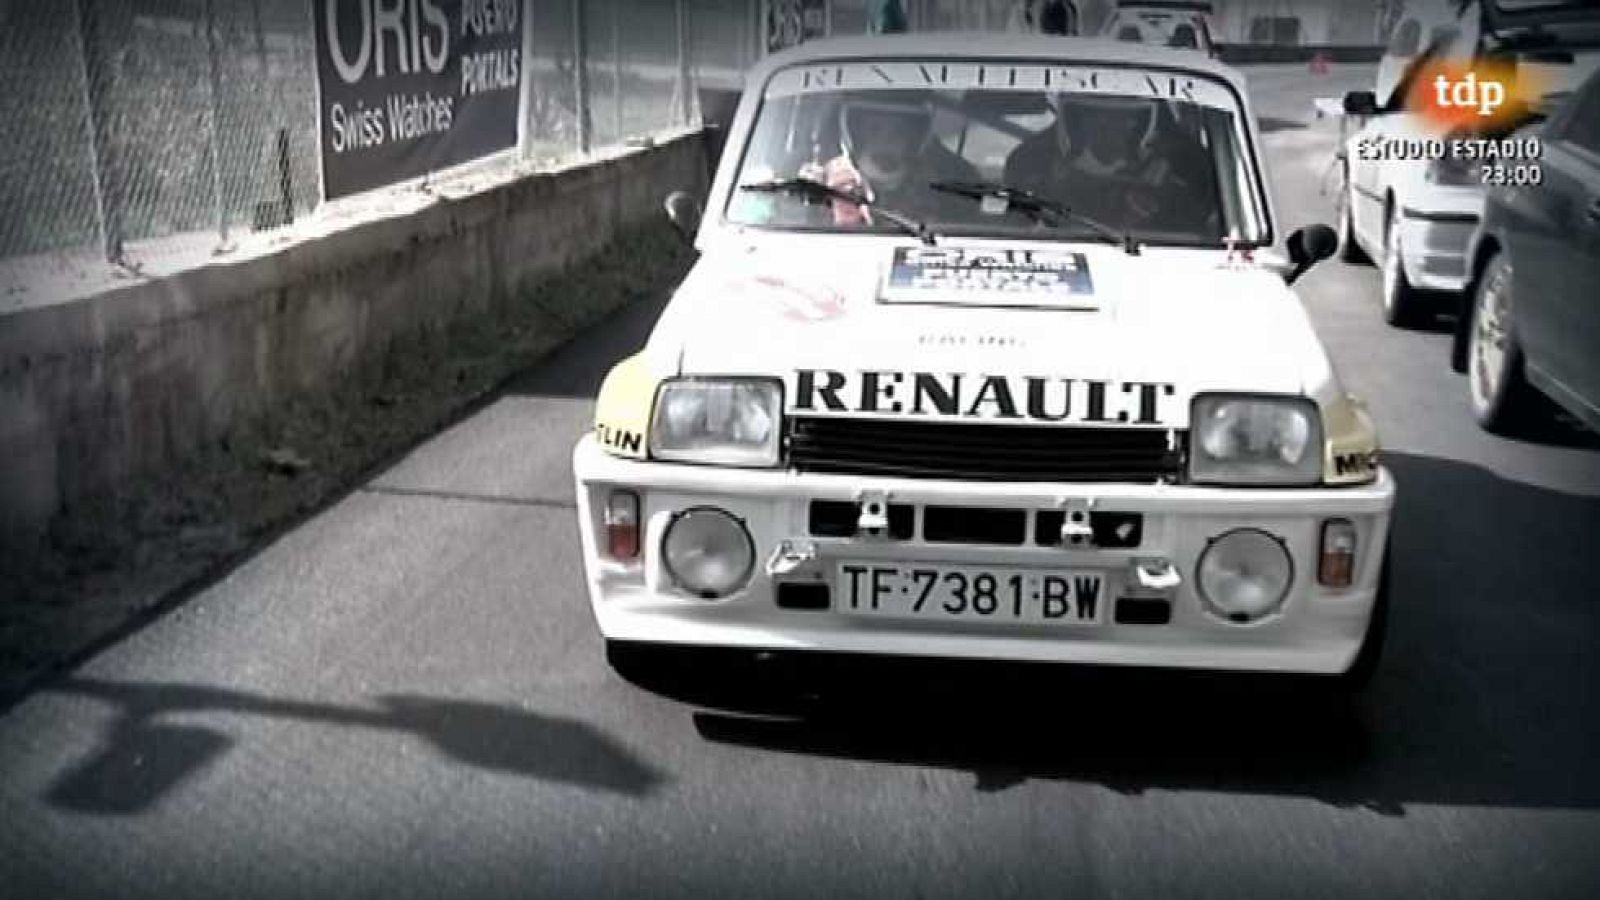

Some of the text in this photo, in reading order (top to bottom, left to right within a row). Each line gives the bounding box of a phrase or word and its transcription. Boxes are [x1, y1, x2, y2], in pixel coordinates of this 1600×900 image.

[327, 0, 449, 83] ORIS
[461, 48, 519, 96] PORTALS
[331, 92, 454, 152] Swiss Watches
[792, 369, 1175, 424] RENAULT
